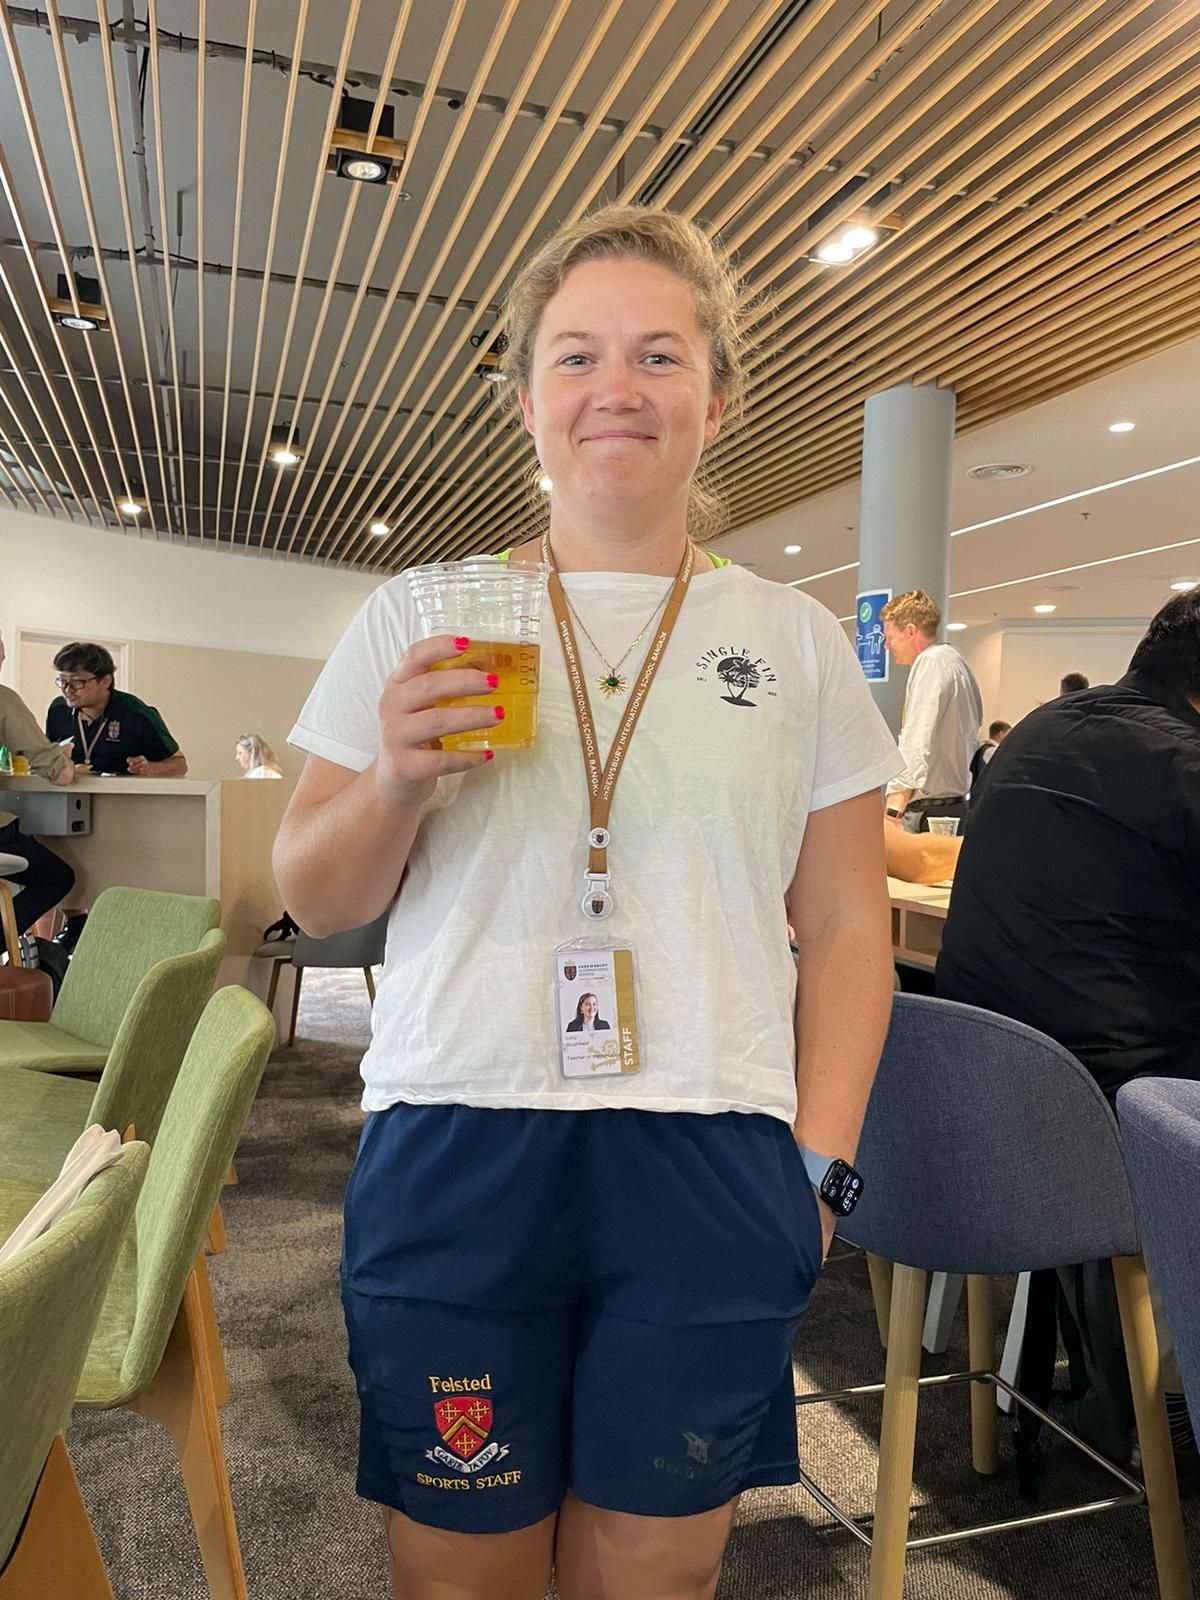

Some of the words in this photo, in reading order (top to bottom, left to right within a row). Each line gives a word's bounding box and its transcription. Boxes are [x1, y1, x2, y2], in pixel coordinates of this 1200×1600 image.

[696, 646, 750, 670] SINGLE
[755, 658, 777, 682] FIN
[560, 620, 575, 664] SHREWSBURY
[571, 664, 589, 721] INTERNATIONAL
[582, 722, 594, 758] SCHOOL
[589, 759, 599, 797] BANGKO
[620, 688, 645, 745] INTERNATIONAL
[640, 663, 656, 687] SCHOOL
[622, 1027, 634, 1066] STAFF
[428, 1374, 492, 1393] Felsted
[416, 1473, 470, 1490] SPORTS
[476, 1471, 521, 1489] STAFF
